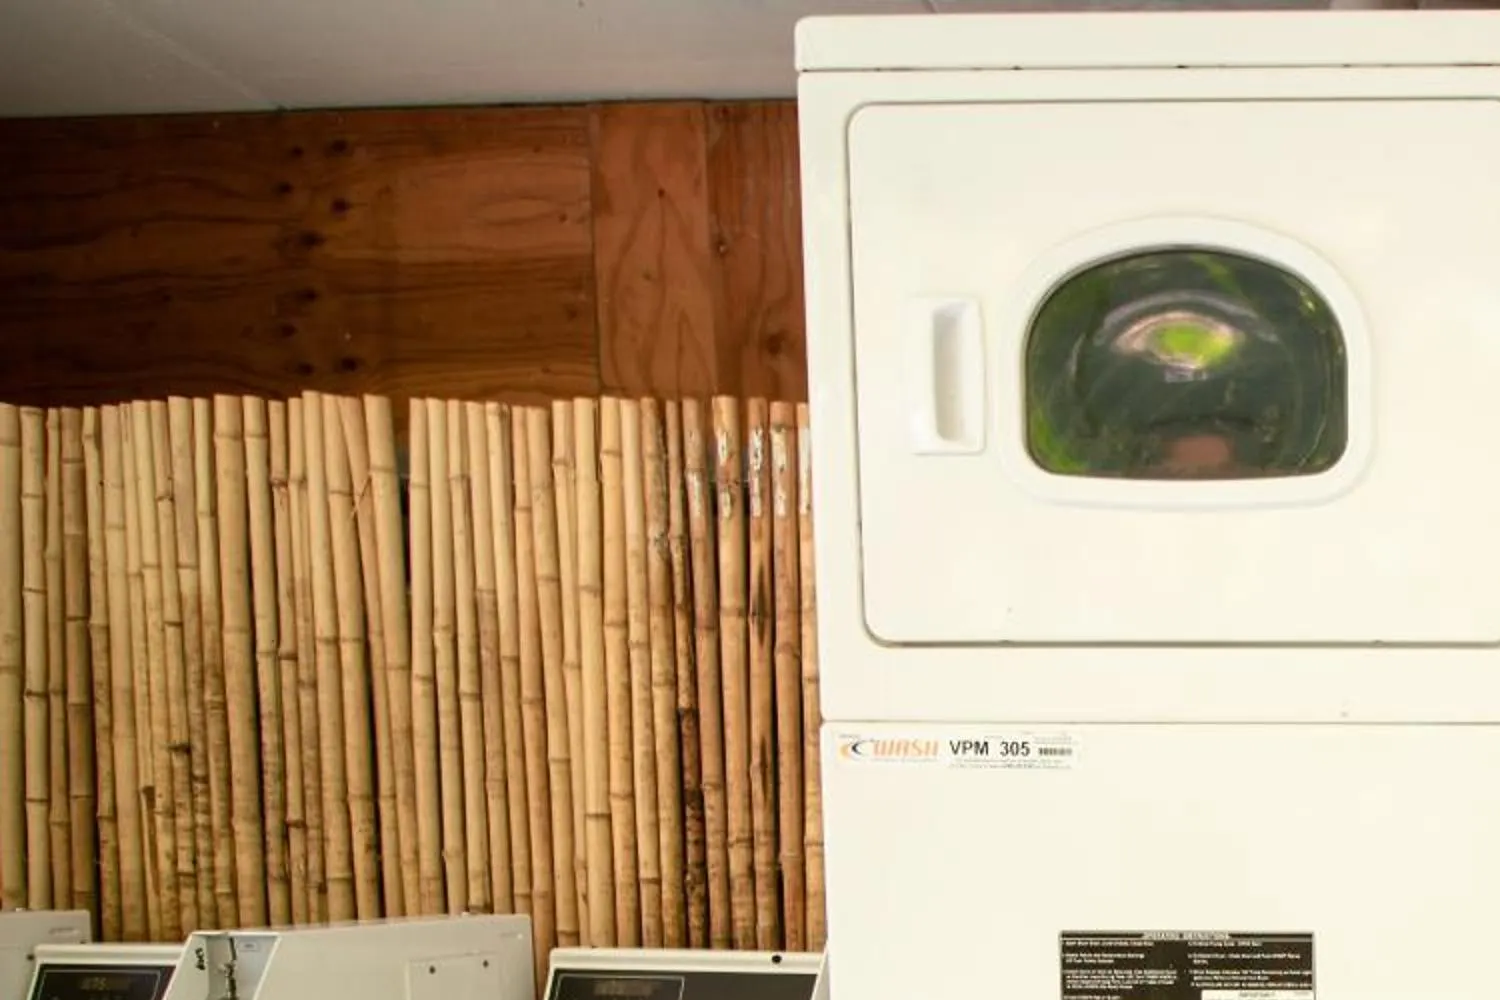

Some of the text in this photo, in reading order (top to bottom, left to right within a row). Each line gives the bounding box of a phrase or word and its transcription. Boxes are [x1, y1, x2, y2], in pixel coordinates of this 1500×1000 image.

[872, 738, 1031, 757] WASH VPM 305
